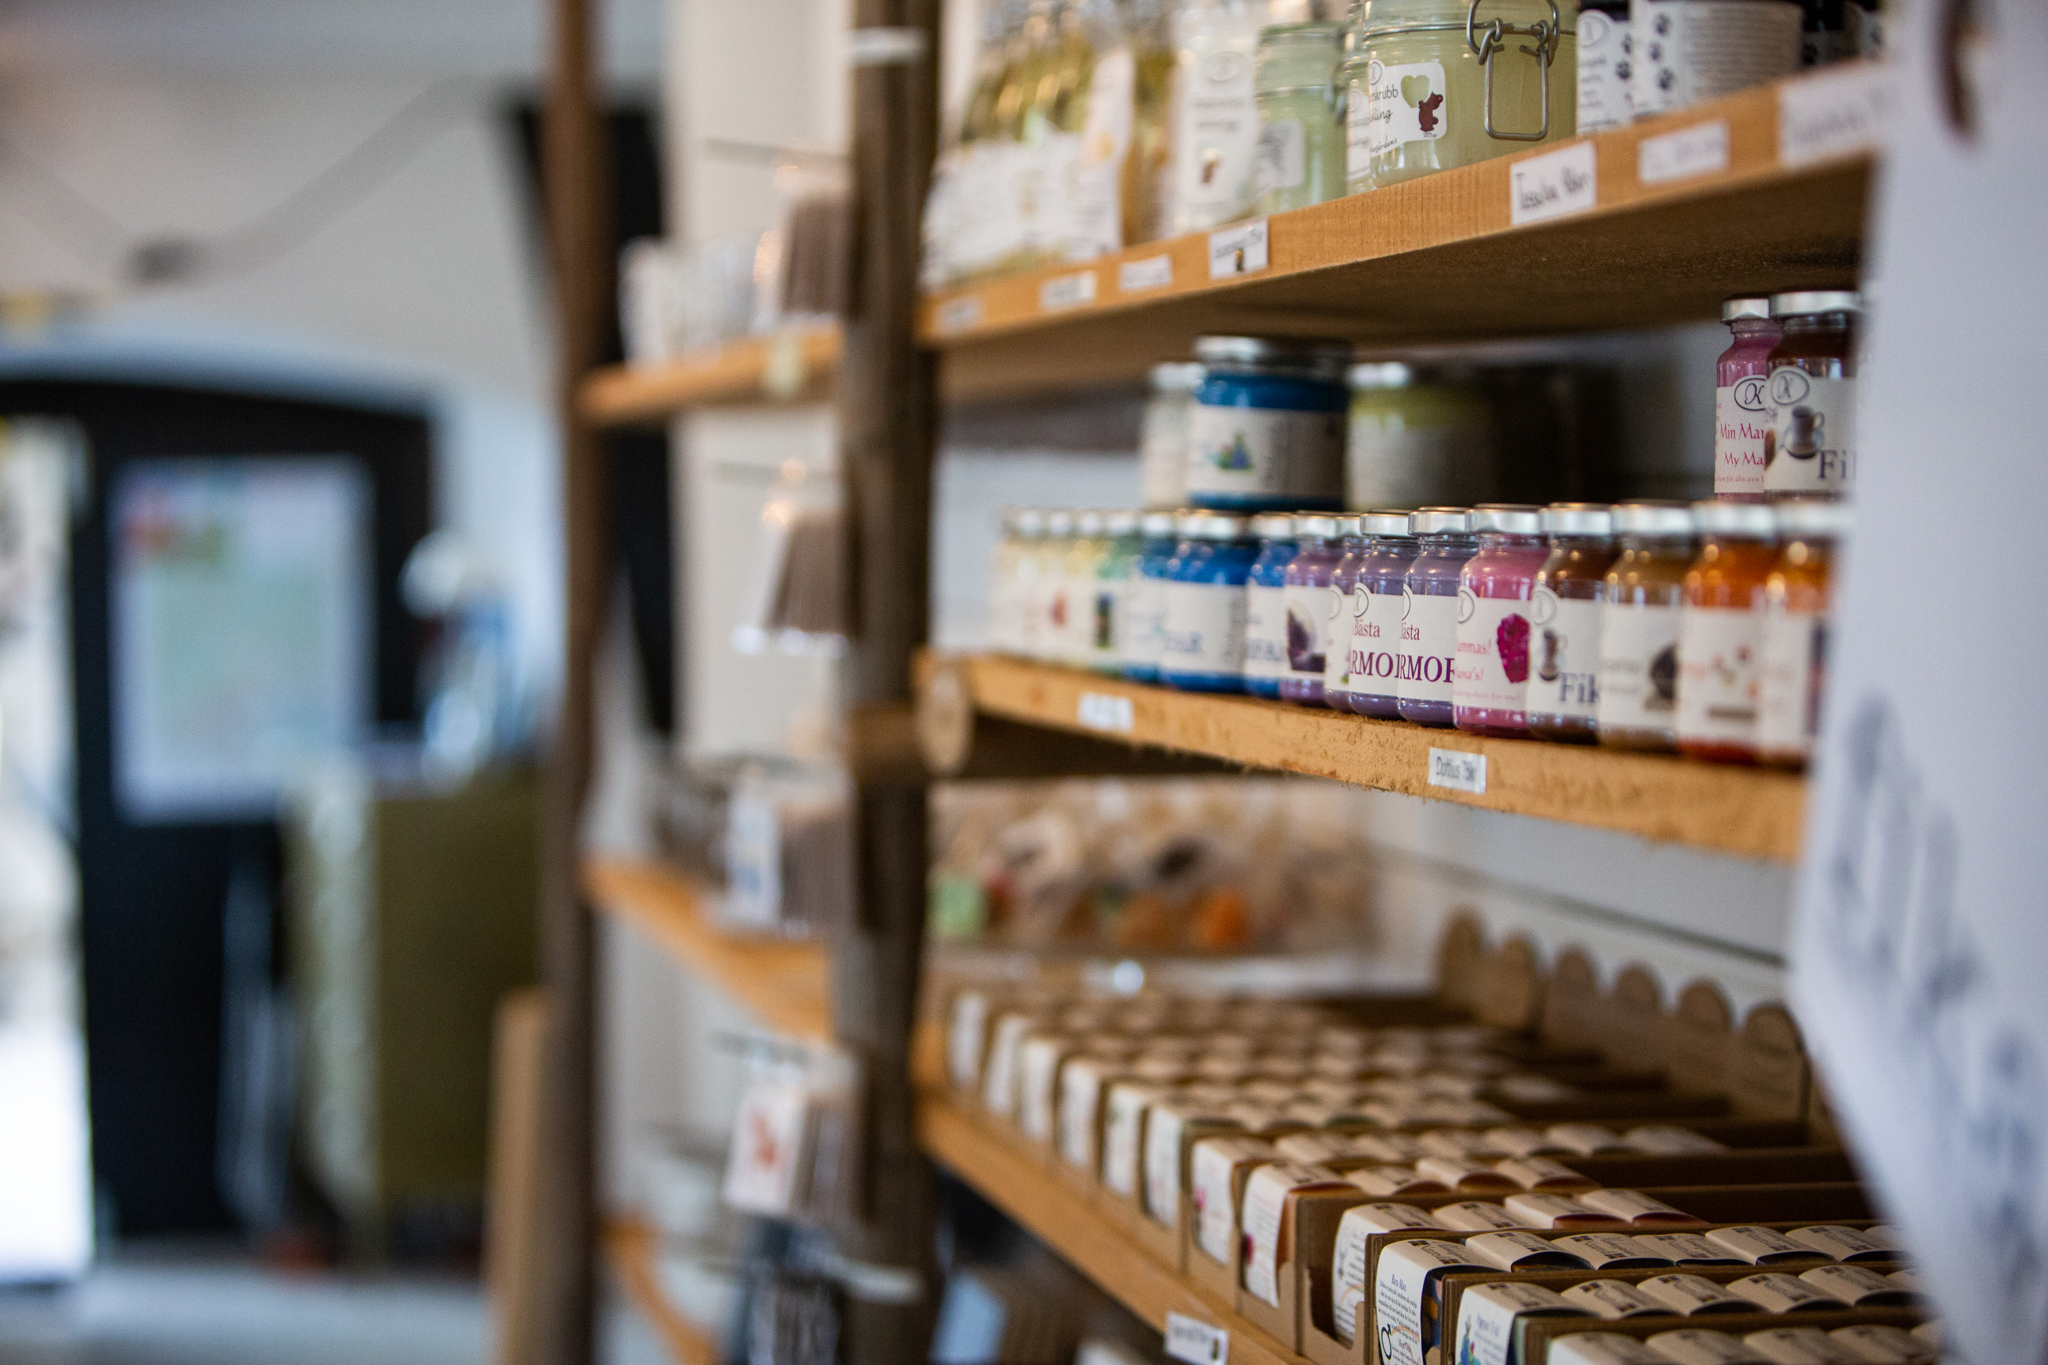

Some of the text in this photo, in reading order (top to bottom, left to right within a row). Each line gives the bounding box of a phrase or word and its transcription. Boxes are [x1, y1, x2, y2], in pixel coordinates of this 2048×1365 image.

[1720, 423, 1737, 440] Min
[1724, 452, 1740, 467] My
[1818, 450, 1856, 479] Fi
[1353, 619, 1380, 638] Bästa
